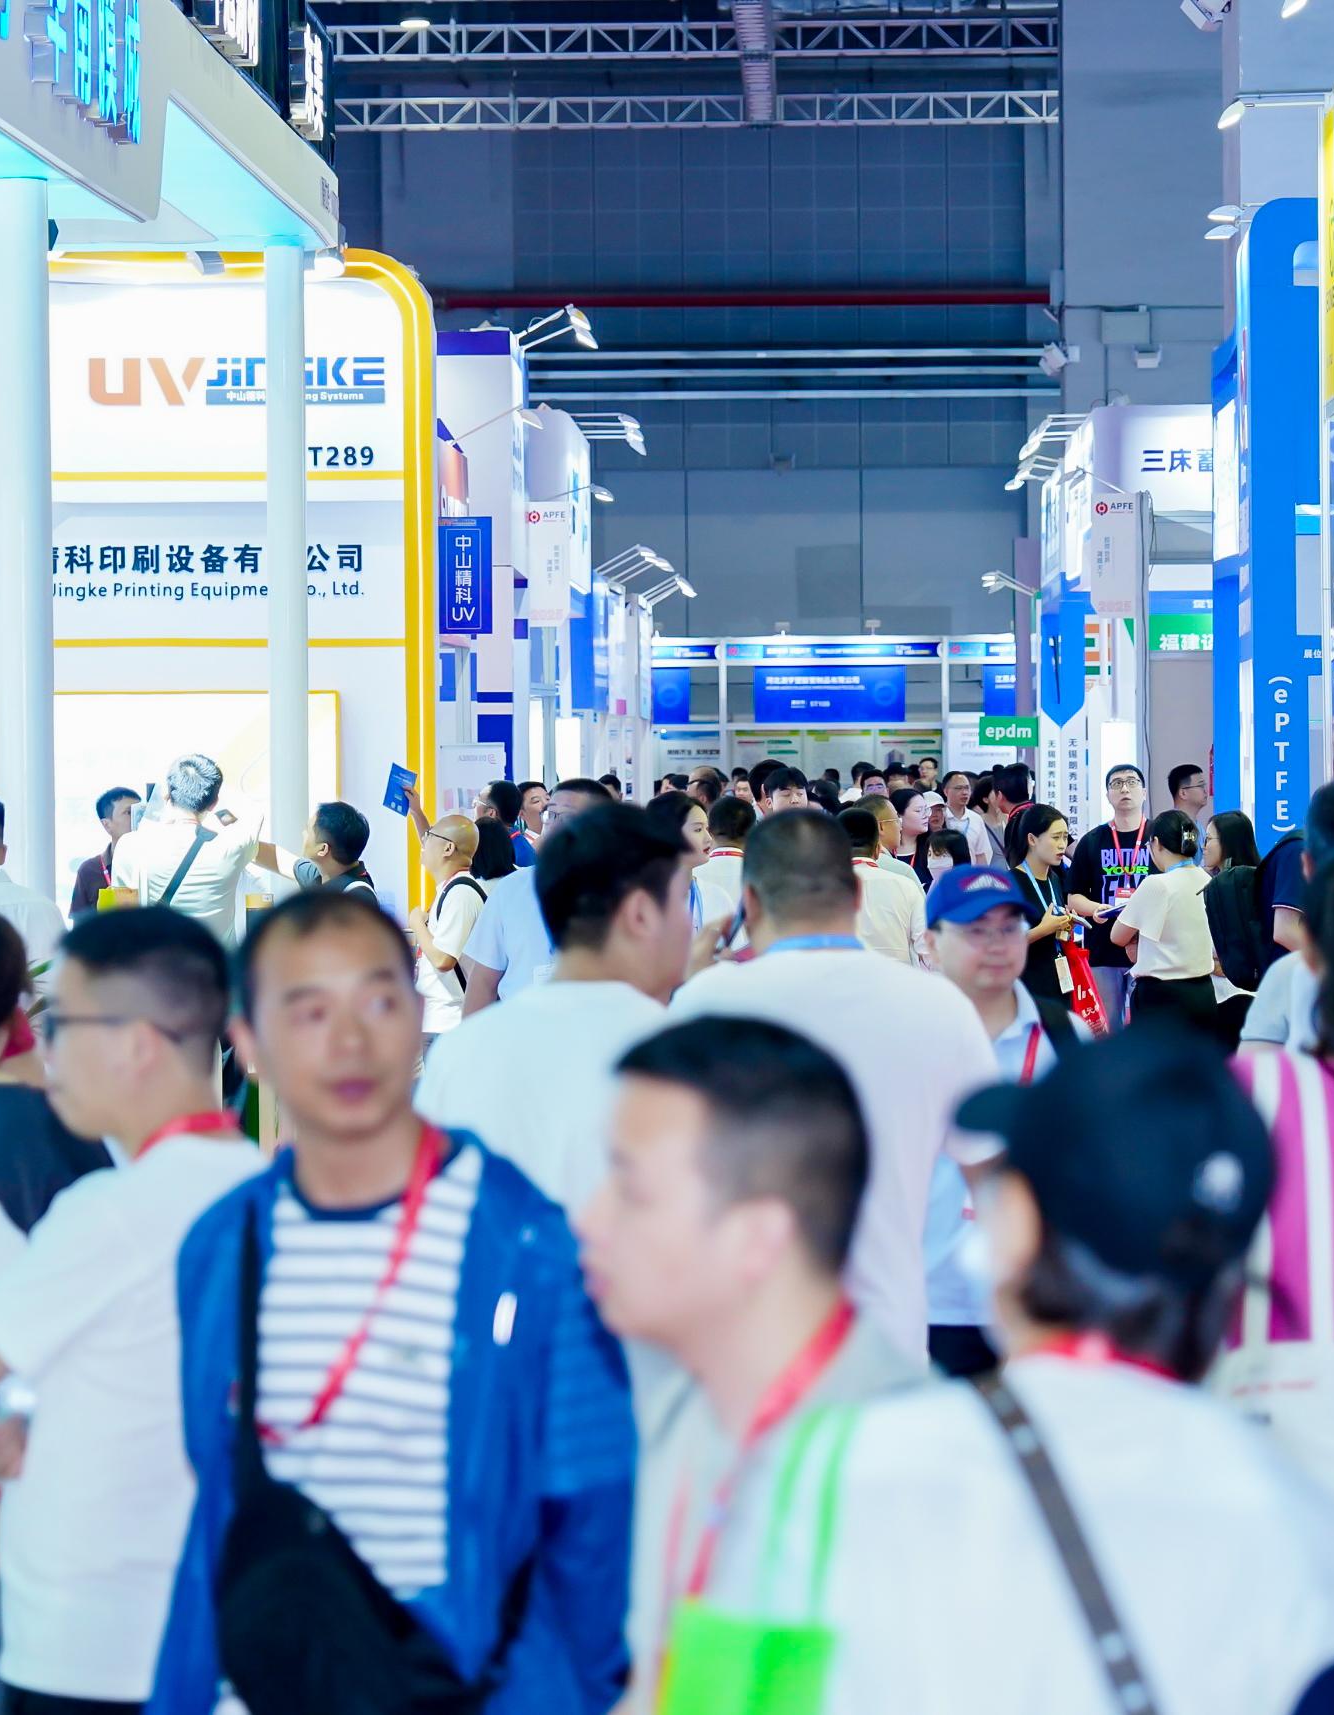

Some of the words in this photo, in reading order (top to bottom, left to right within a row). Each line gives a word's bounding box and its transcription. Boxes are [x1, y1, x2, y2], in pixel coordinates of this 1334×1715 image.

[88, 357, 205, 406] UV
[320, 391, 364, 402] Systems
[1110, 502, 1134, 510] APFE
[543, 511, 566, 519] APFE
[113, 581, 184, 600] Printing
[191, 581, 268, 600] Equipme
[332, 581, 364, 596] Ltd.
[985, 724, 1032, 741] epdm
